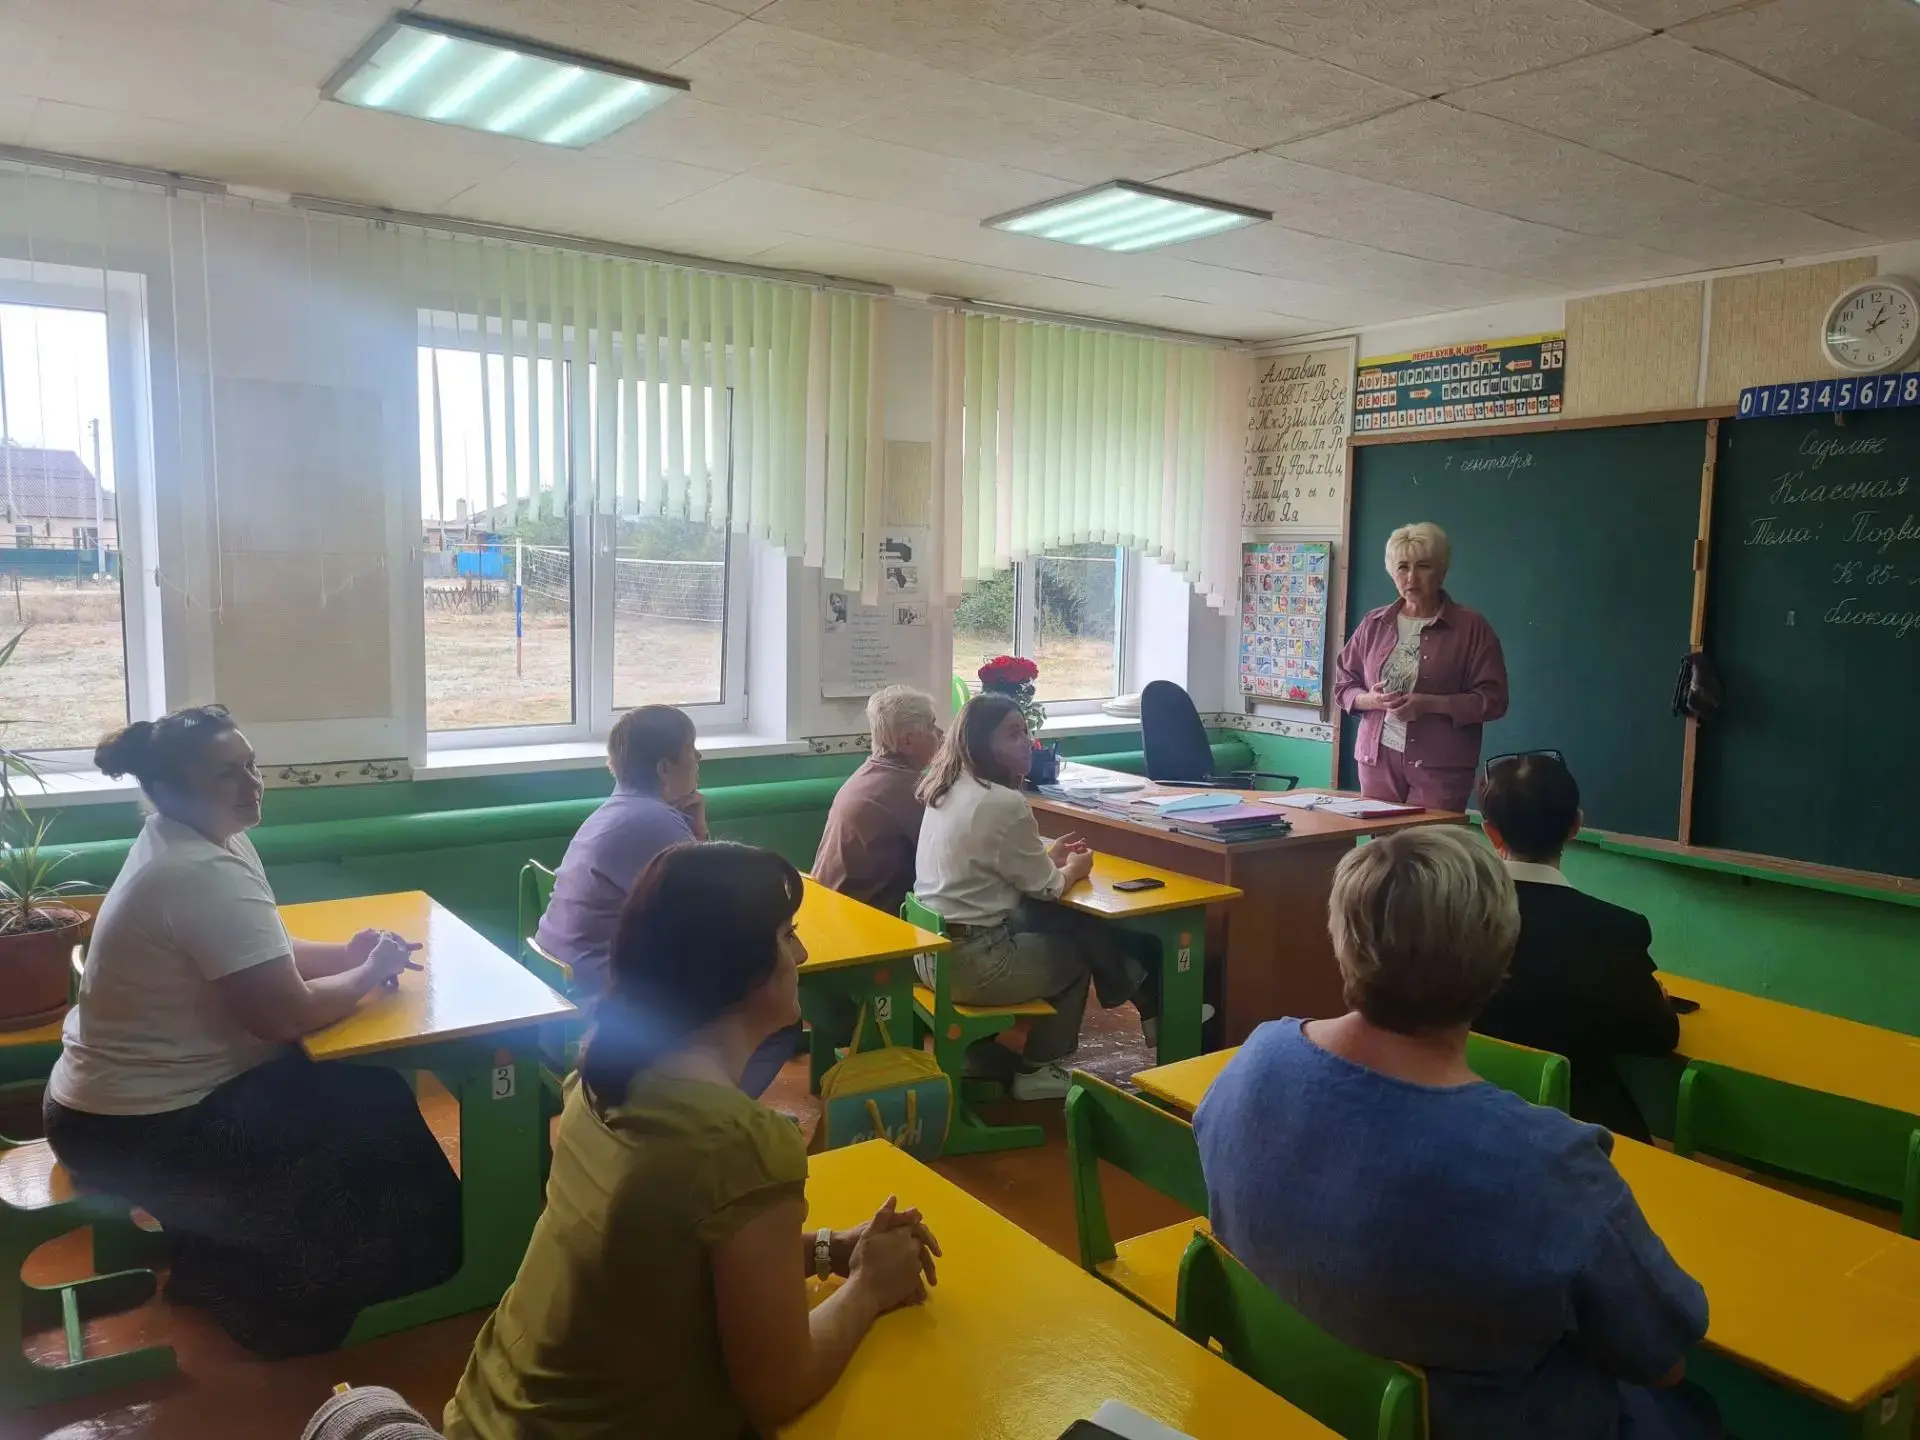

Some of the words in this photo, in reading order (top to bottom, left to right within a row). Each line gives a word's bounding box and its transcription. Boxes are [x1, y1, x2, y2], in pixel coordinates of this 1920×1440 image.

[1856, 299, 1864, 309] 11
[1871, 292, 1882, 303] 12
[1890, 295, 1894, 305] 1
[1843, 312, 1854, 321] 10
[1898, 304, 1906, 315] 2
[1902, 319, 1910, 330] 3
[1412, 350, 1434, 360] ЛЕНТА
[1436, 347, 1454, 357] БУКВ
[1464, 343, 1488, 354] ЦИФР
[1852, 349, 1860, 360] 7
[1868, 352, 1876, 362] 6
[1884, 346, 1891, 356] 5
[1358, 378, 1364, 389] А
[1367, 378, 1372, 388] О
[1375, 377, 1380, 386] У
[1408, 372, 1413, 382] Р
[1416, 371, 1422, 382] Л
[1434, 368, 1440, 380] Н
[1444, 368, 1448, 378] Б
[1453, 366, 1458, 376] В
[1462, 364, 1468, 376] Г
[1472, 363, 1478, 374] З
[1482, 362, 1489, 376] Д
[1491, 362, 1500, 374] Ж
[1543, 356, 1548, 366] Ь
[1554, 354, 1561, 364] Ъ
[1358, 398, 1363, 407] Я
[1372, 396, 1380, 405] Ю
[1382, 394, 1387, 404] Е
[1390, 394, 1396, 404] И
[1444, 388, 1449, 398] П
[1451, 386, 1458, 396] Ф
[1462, 385, 1470, 395] К
[1473, 384, 1478, 394] С
[1482, 383, 1488, 393] Т
[1502, 381, 1509, 392] Ц
[1512, 378, 1520, 389] Ч
[1534, 376, 1541, 388] Х
[1741, 394, 1752, 414] 0
[1760, 391, 1770, 412] 1
[1777, 389, 1790, 411] 2
[1798, 387, 1809, 409] 3
[1818, 386, 1831, 407] 4
[1838, 384, 1852, 406] 5
[1860, 382, 1873, 404] 6
[1882, 380, 1896, 403] 7
[1904, 378, 1918, 401] 8
[1356, 419, 1361, 427] 0
[1374, 416, 1378, 425] 2
[1382, 416, 1387, 424] 3
[1390, 415, 1396, 424] 4
[1400, 414, 1404, 422] 5
[1409, 413, 1414, 422] 6
[1418, 412, 1422, 420] 7
[1438, 410, 1442, 420] 9
[1456, 408, 1463, 417] 11
[1466, 407, 1473, 416] 12
[1476, 406, 1482, 416] 13
[1486, 406, 1493, 414] 14
[1496, 404, 1504, 414] 15
[1506, 403, 1514, 412] 16
[1518, 402, 1525, 411] 17
[1528, 401, 1536, 410] 18
[1540, 400, 1547, 409] 19
[1550, 398, 1559, 408] 20
[1770, 471, 1910, 503] Классная
[1180, 952, 1188, 969] 4
[878, 998, 890, 1018] 2
[496, 1068, 512, 1096] 3
